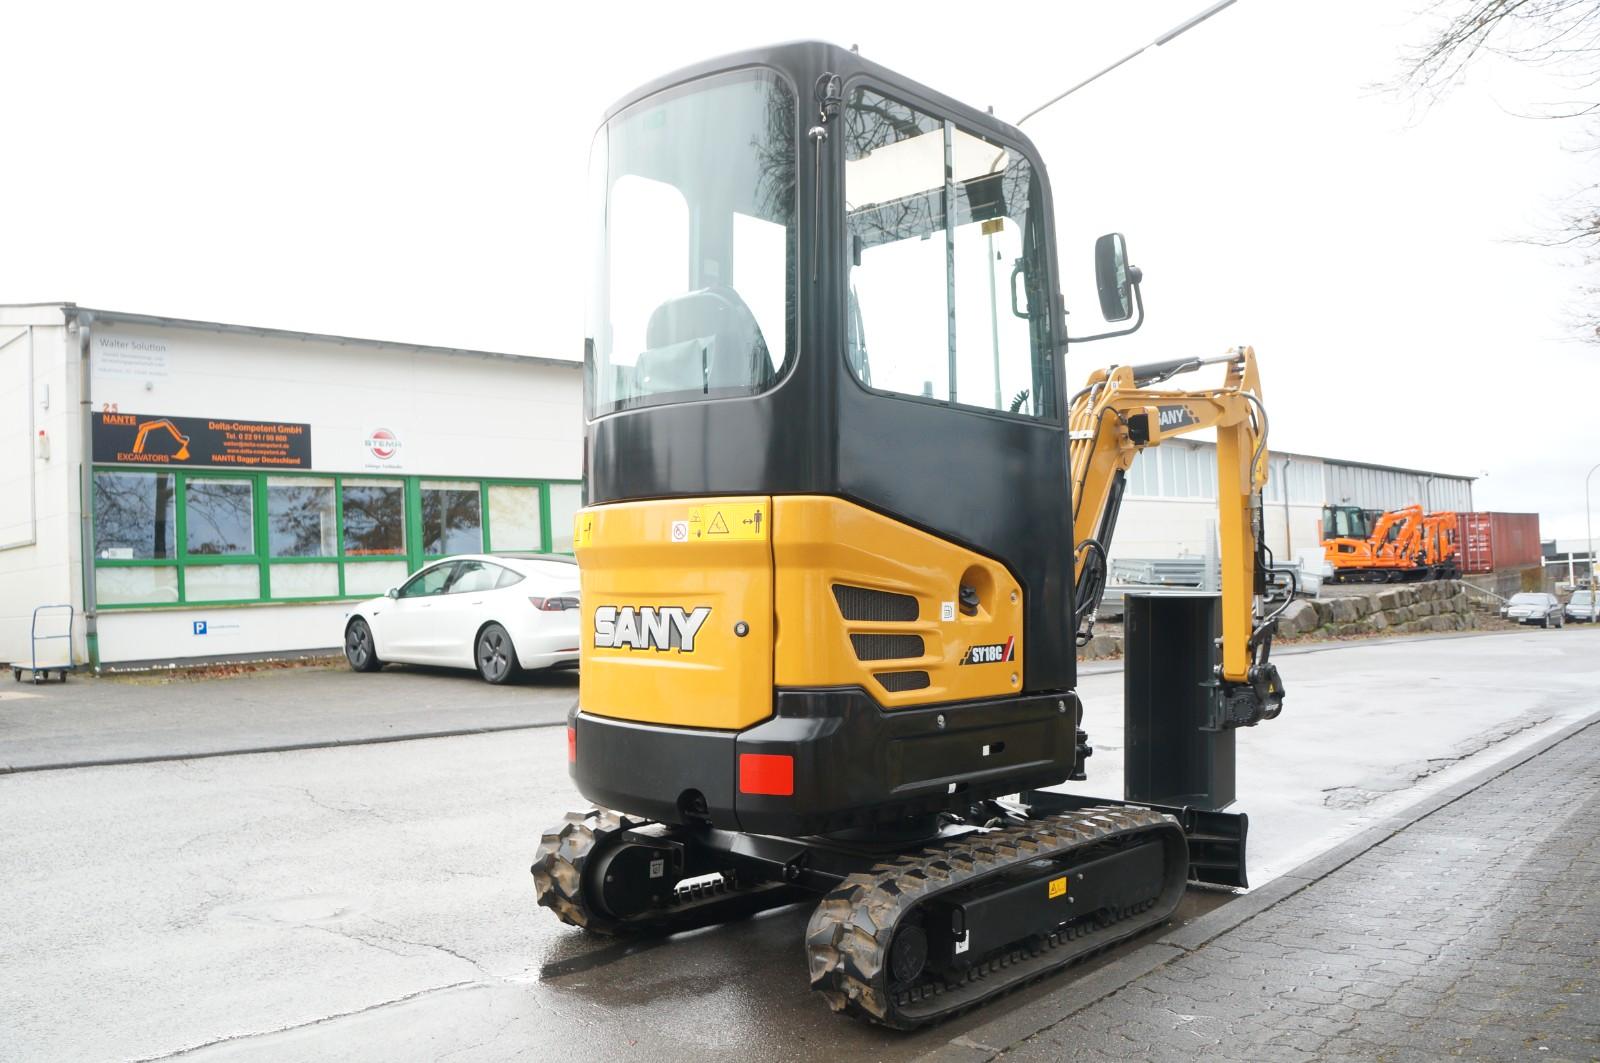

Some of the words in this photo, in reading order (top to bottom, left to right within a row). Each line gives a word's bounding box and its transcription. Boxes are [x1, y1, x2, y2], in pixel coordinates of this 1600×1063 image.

[101, 339, 128, 349] Walter
[132, 341, 166, 352] Solution
[103, 415, 136, 426] NANTE
[208, 422, 276, 433] Delta-Competent
[117, 452, 169, 462] EXCAVATORS
[212, 455, 236, 463] NANTE
[594, 605, 712, 653] SANY
[972, 646, 1002, 662] SY18C
